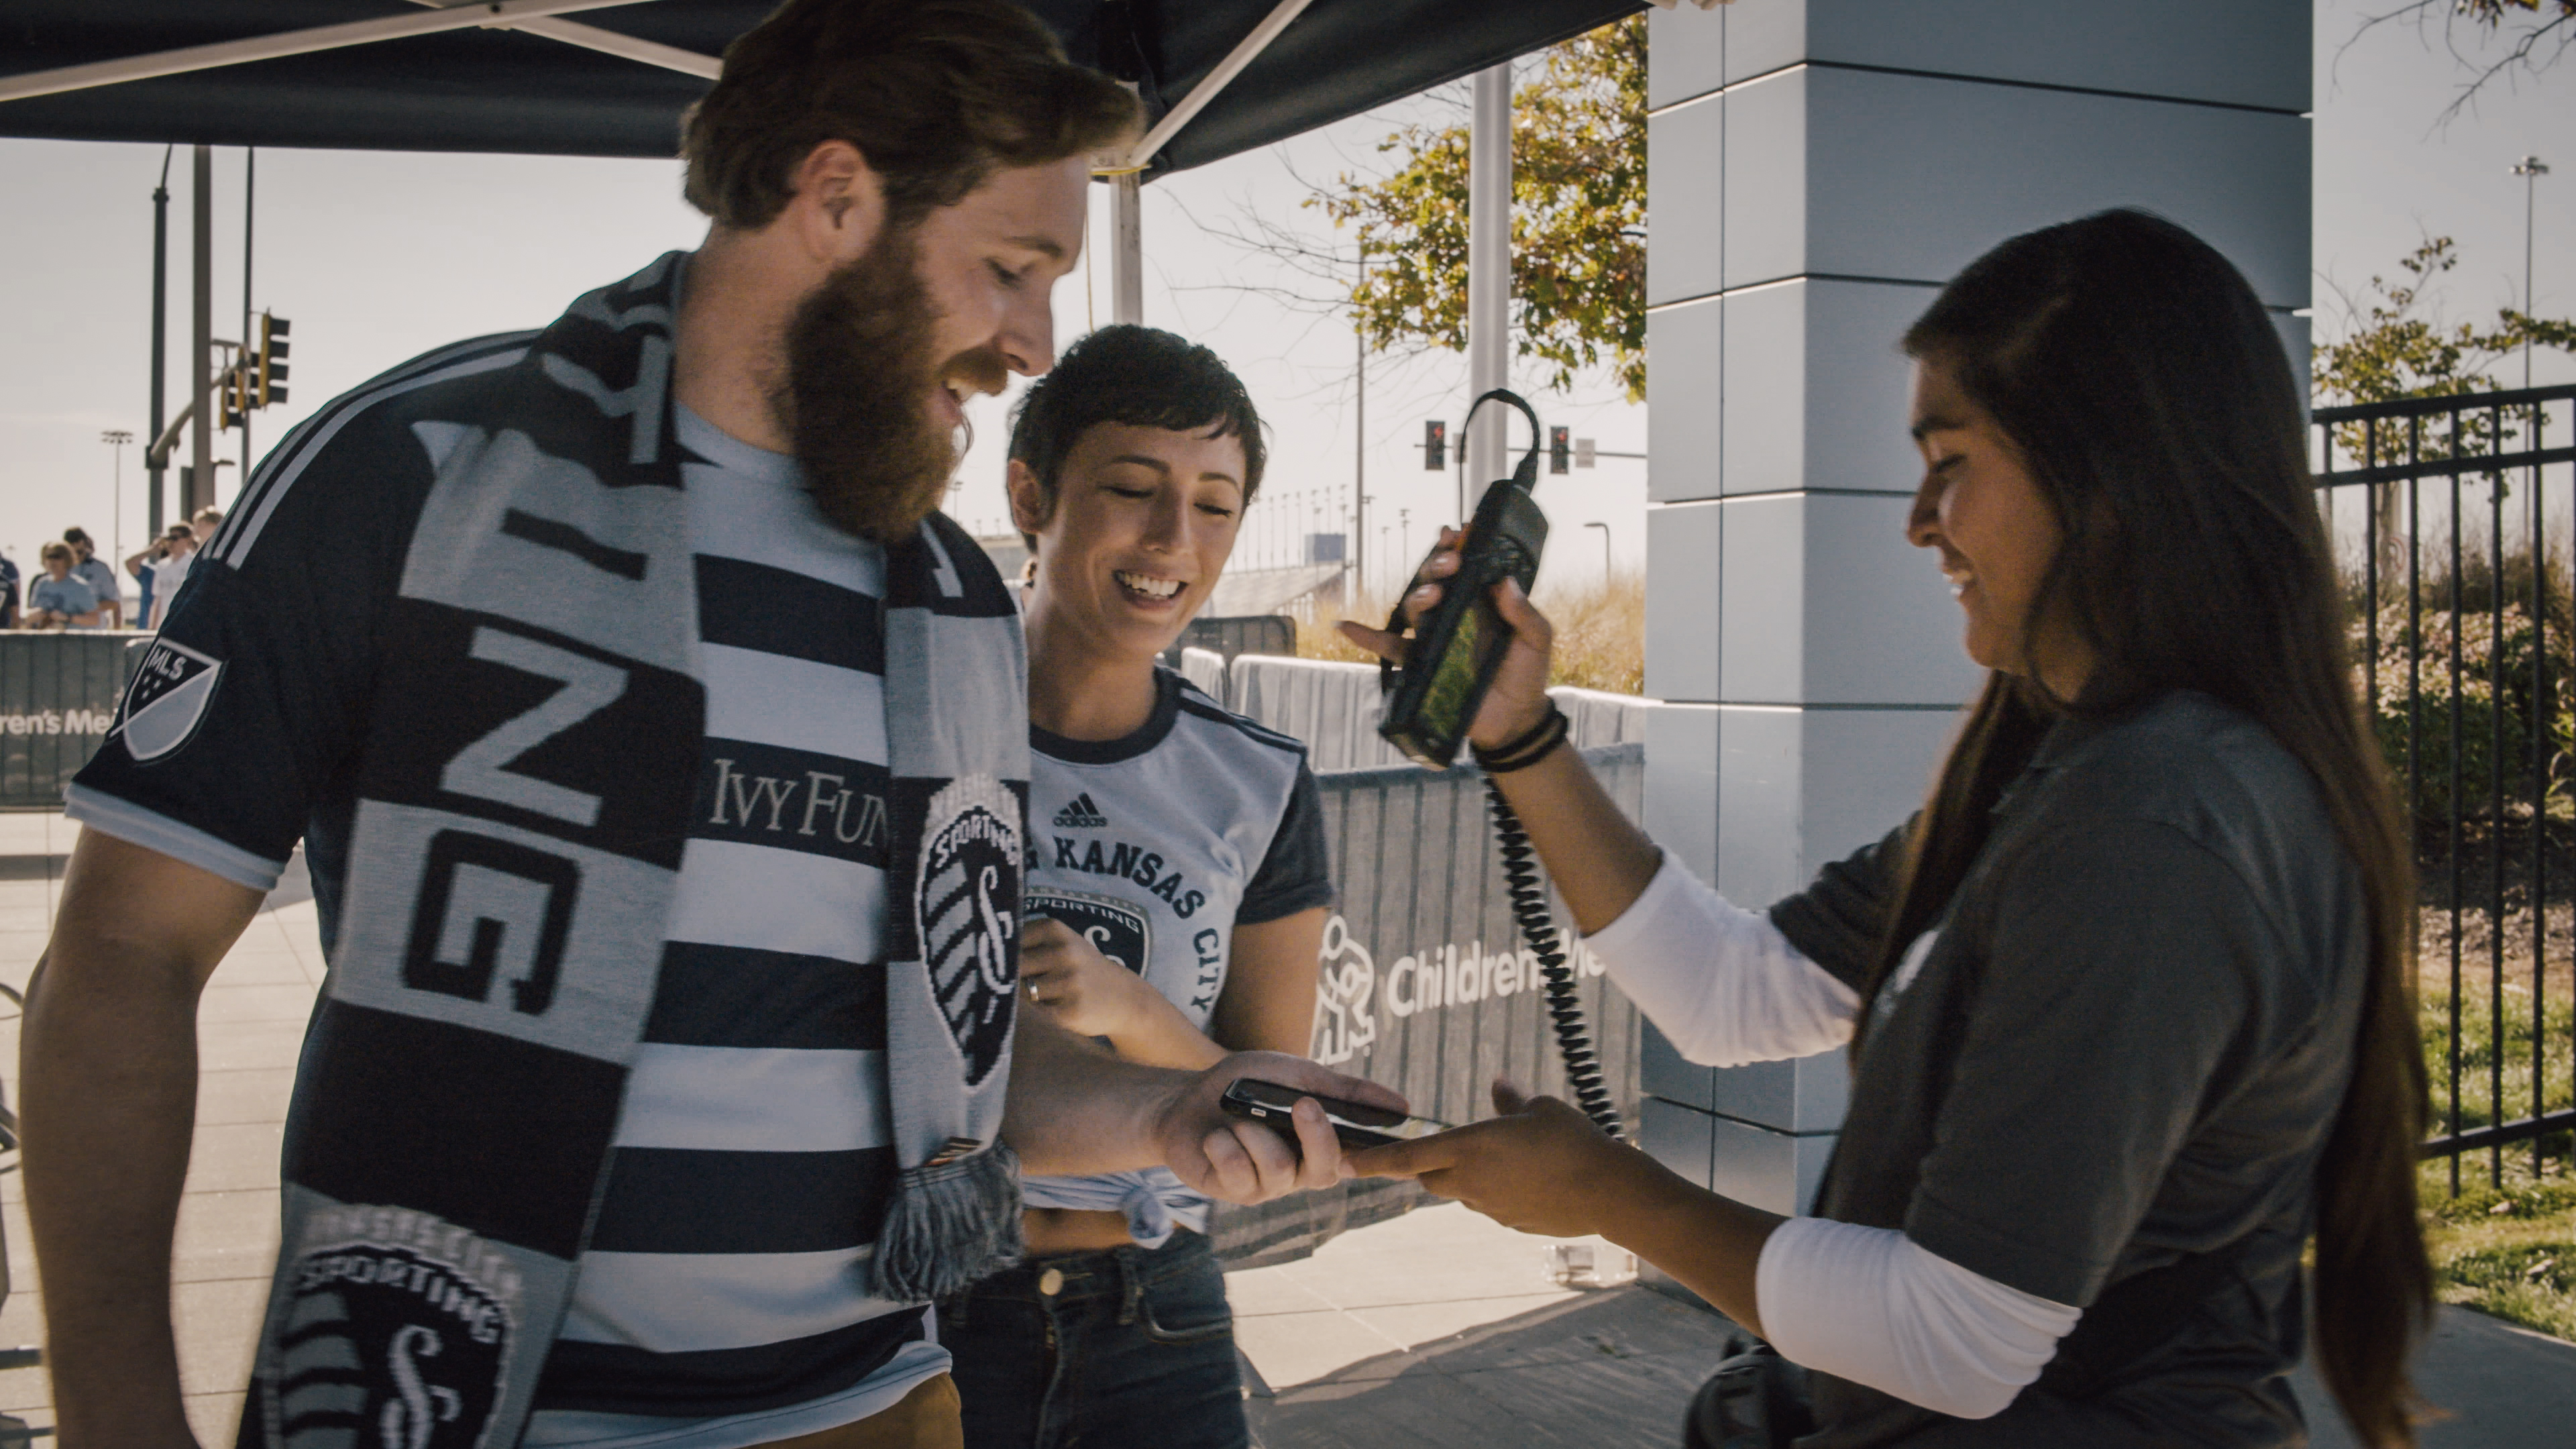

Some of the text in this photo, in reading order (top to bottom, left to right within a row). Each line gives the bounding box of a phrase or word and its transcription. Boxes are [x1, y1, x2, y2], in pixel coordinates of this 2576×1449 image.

[148, 645, 185, 681] MLS
[64, 708, 116, 735] Me
[1053, 814, 1108, 827] adidas
[1024, 898, 1140, 934] SPORTING
[1052, 835, 1205, 920] KANSAS
[1189, 927, 1220, 1012] CITY
[1387, 940, 1553, 1018] Children
[297, 1254, 504, 1344] SPORTING
